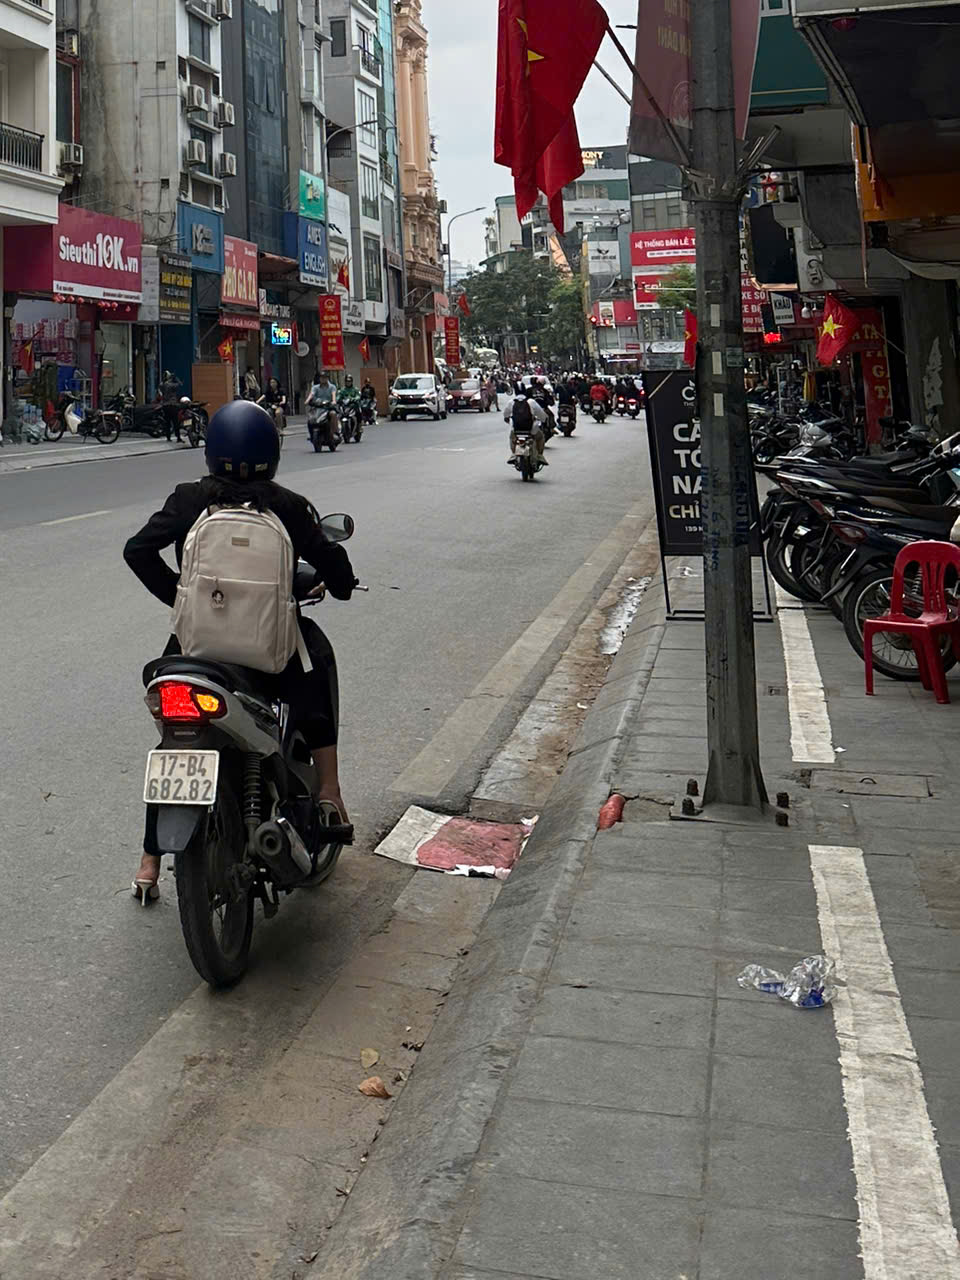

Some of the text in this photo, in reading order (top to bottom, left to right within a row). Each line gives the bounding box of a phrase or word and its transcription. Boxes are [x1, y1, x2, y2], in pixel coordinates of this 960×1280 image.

[674, 475, 703, 495] NA
[160, 755, 207, 776] 17-B4
[149, 778, 212, 801] 682.82
